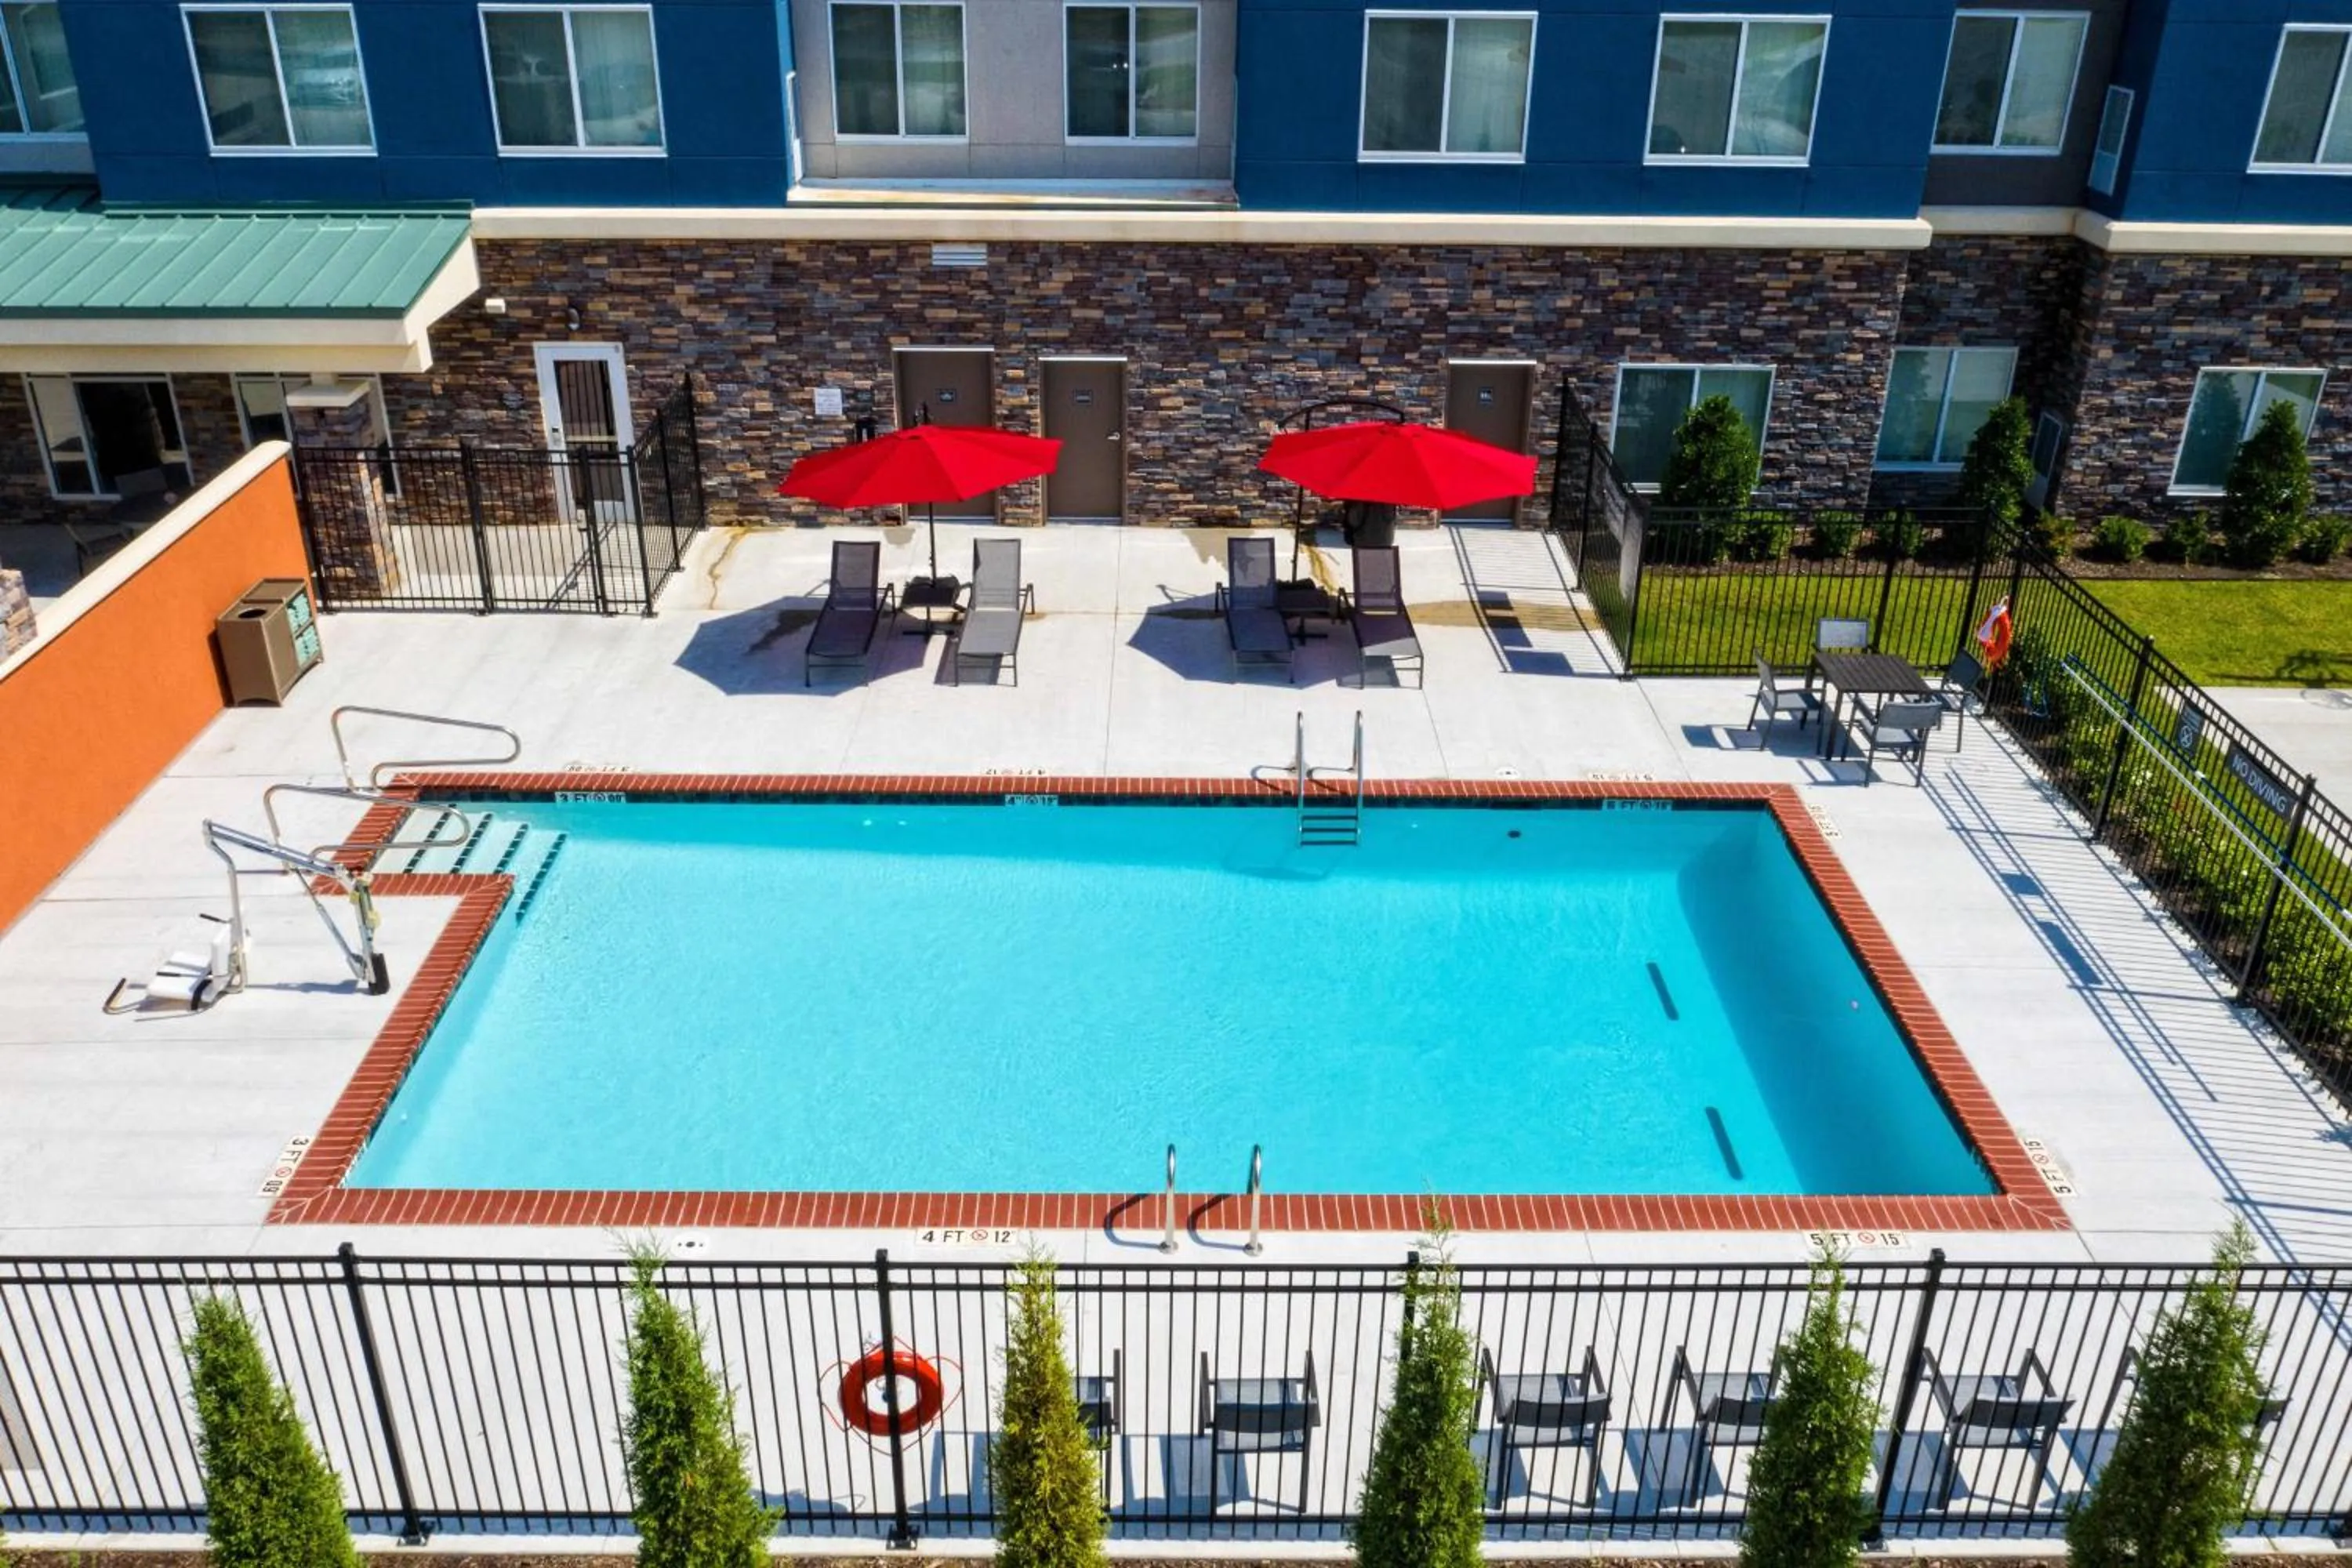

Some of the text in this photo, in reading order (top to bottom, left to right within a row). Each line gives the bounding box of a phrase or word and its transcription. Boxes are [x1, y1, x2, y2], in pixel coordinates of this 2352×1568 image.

[2248, 771, 2288, 812] DIVING
[281, 1150, 303, 1164] FT
[2042, 1168, 2064, 1181] FT
[922, 1230, 935, 1243] 4
[943, 1230, 965, 1243] FT
[1809, 1233, 1825, 1246] 5
[1831, 1232, 1851, 1246] FT
